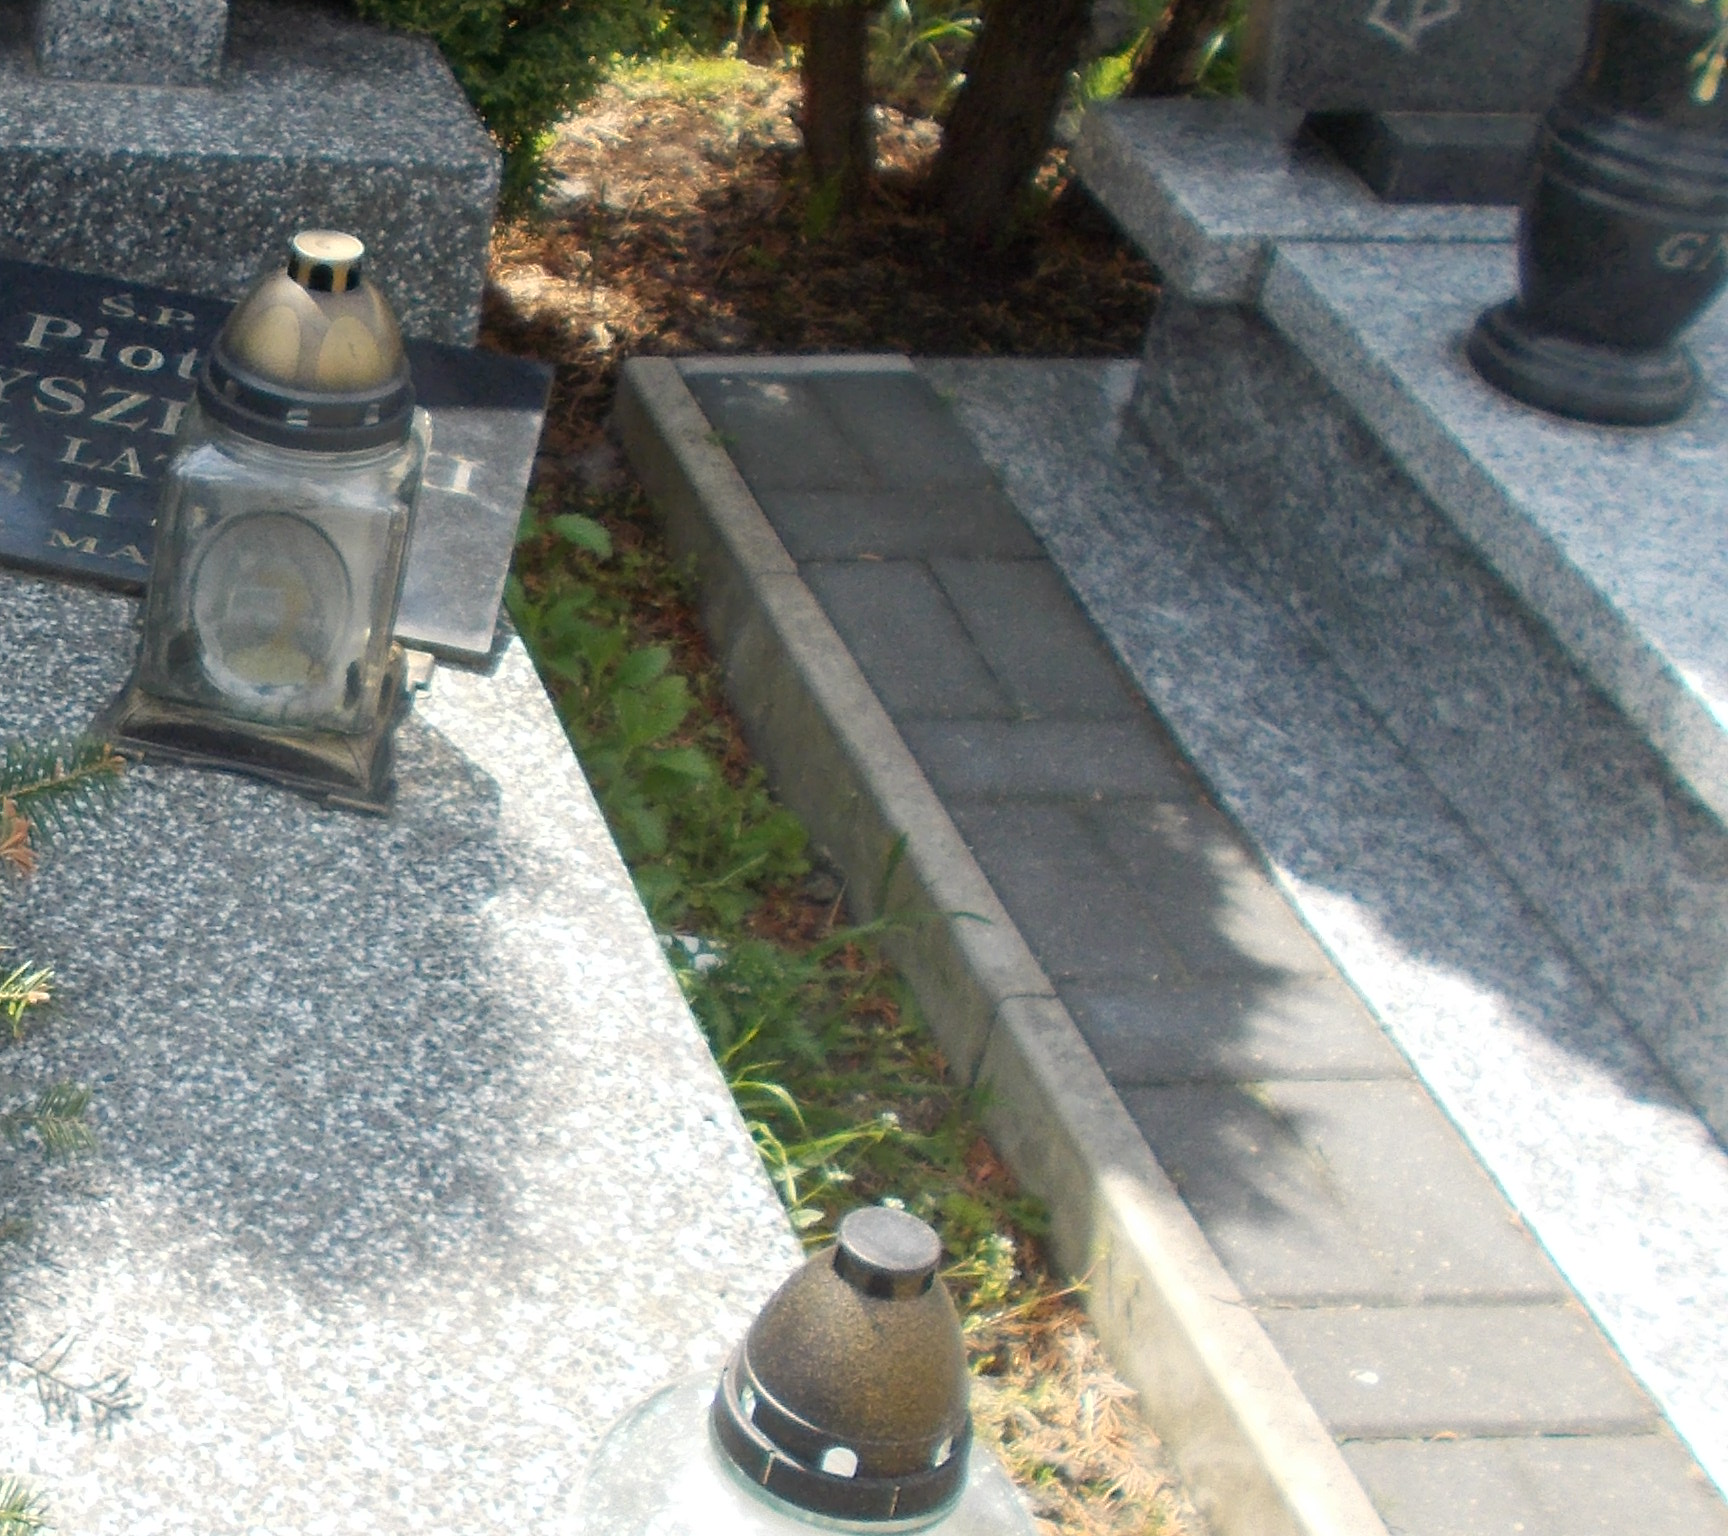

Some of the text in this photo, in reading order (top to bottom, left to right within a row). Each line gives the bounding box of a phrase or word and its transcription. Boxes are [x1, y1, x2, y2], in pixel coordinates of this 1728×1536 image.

[17, 311, 201, 381] Piot
[58, 434, 168, 481] LA
[46, 526, 152, 568] MA
